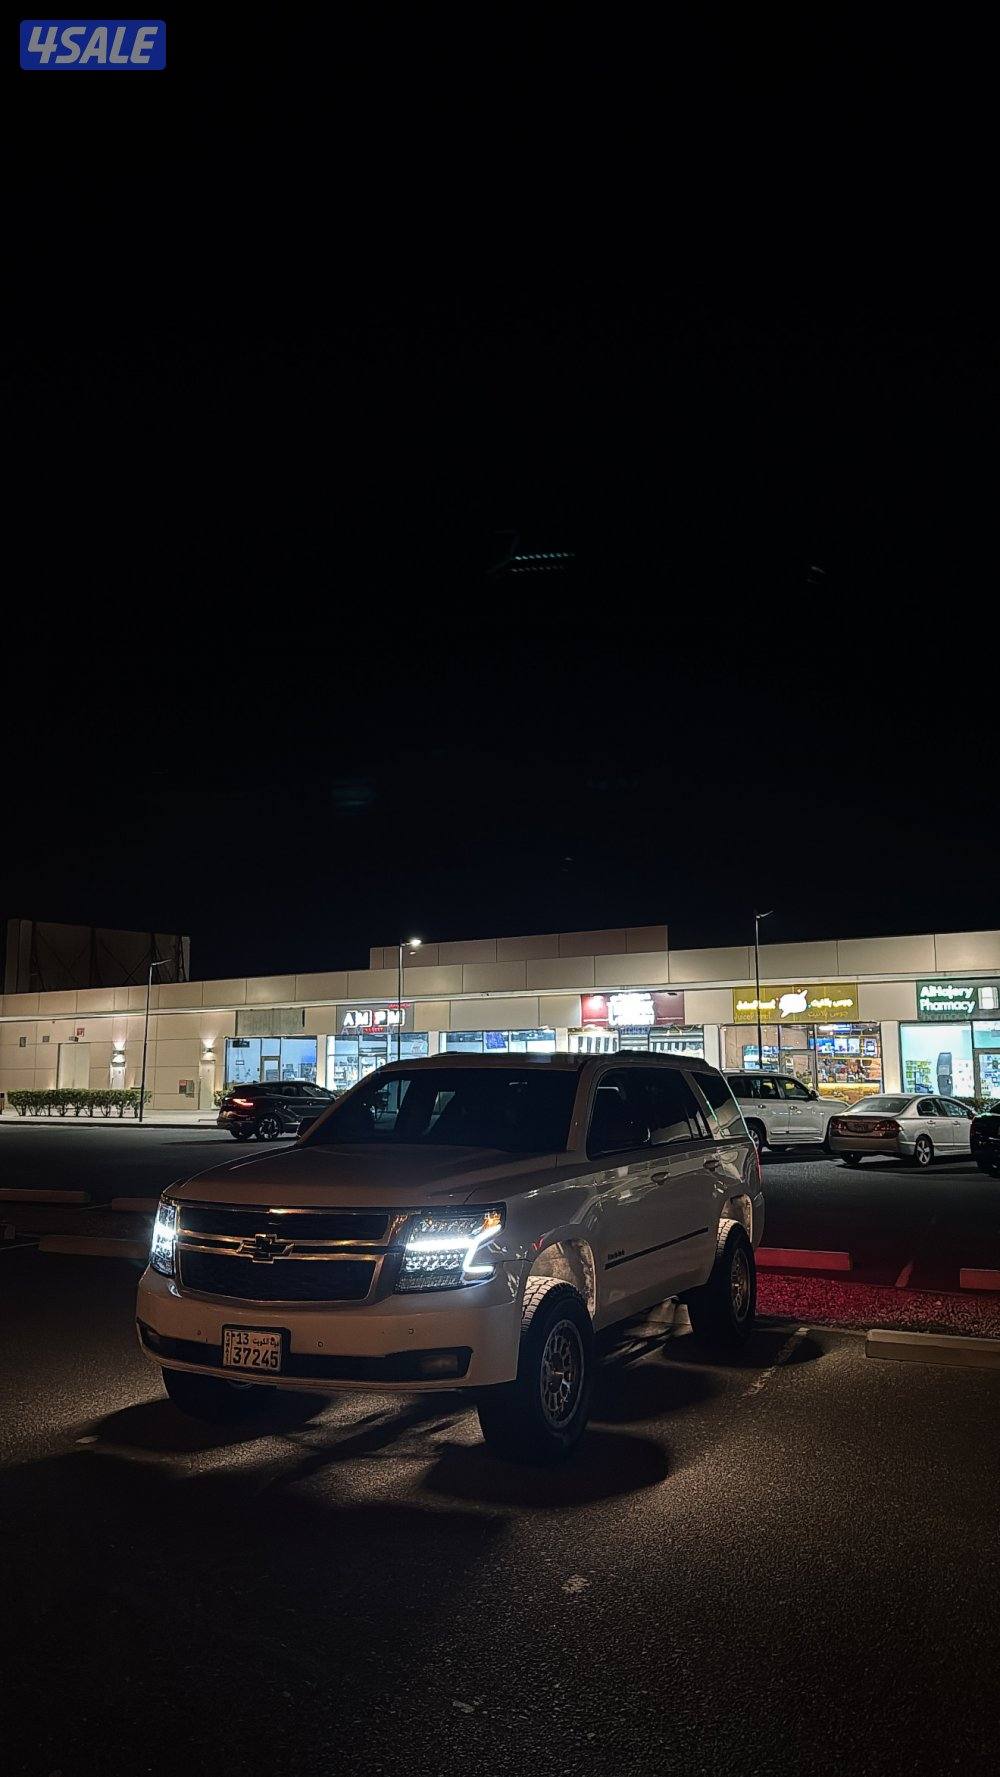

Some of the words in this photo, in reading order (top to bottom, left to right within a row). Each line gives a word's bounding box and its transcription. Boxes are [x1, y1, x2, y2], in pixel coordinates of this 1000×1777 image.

[920, 998, 976, 1013] Pharmacy
[237, 1333, 249, 1345] 13
[233, 1347, 279, 1368] 37245
